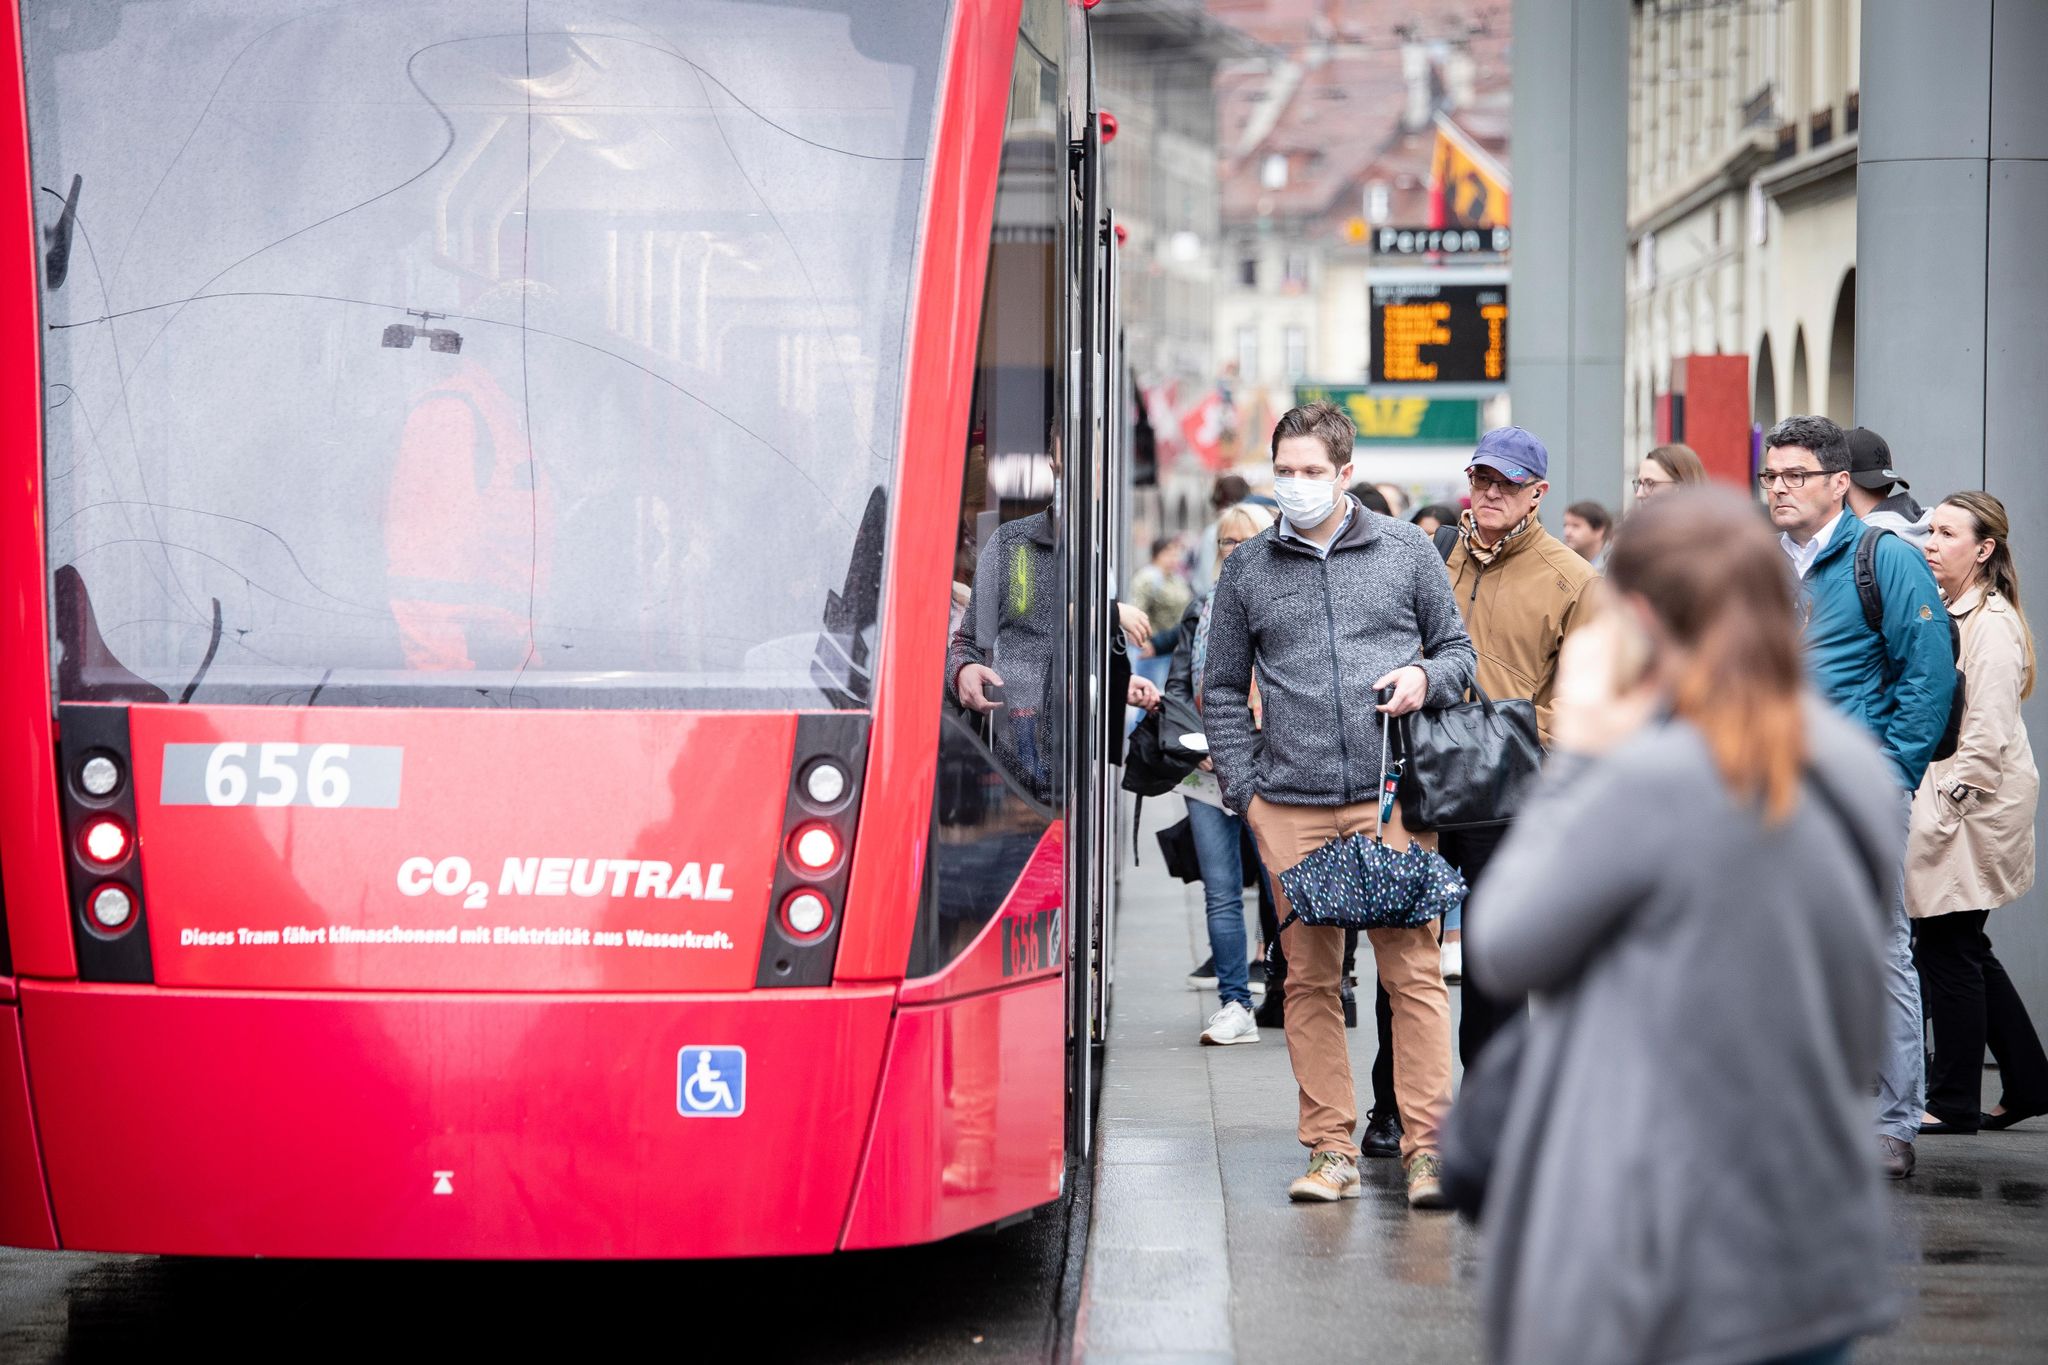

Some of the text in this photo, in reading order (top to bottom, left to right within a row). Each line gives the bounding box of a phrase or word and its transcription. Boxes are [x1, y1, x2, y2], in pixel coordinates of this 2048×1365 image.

[1380, 227, 1480, 253] Perron
[205, 742, 350, 808] 656
[498, 857, 734, 901] NEUTRAL
[180, 925, 734, 949] Dieses Tram fährt klimaschonend mit Elektrizität aus Wasserkraft.
